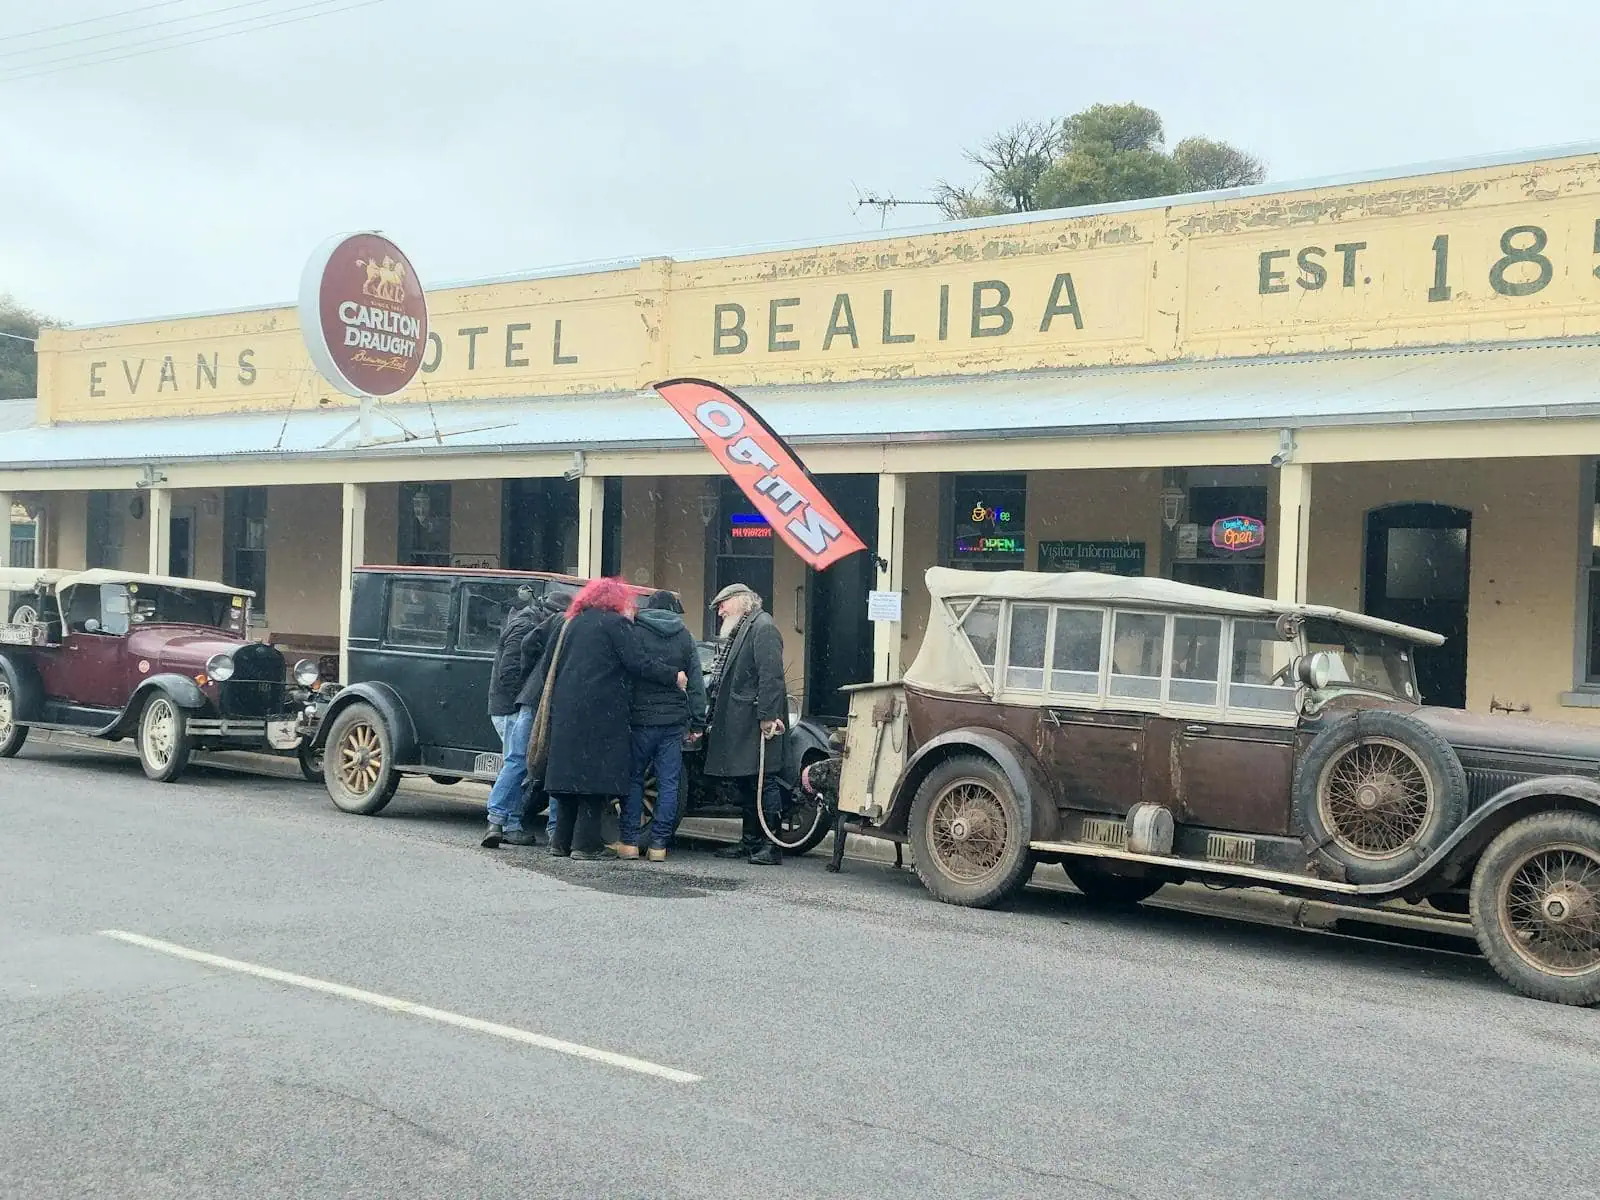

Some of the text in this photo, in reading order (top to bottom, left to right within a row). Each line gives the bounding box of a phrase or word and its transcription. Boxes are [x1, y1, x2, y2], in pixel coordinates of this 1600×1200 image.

[90, 349, 257, 397] EVANS
[421, 320, 578, 373] OTEL
[713, 273, 1084, 355] BEALIBA
[1259, 241, 1371, 294] EST.
[339, 301, 420, 339] CARLTON
[344, 326, 415, 357] DRAUGHT
[1041, 543, 1141, 559] Visitor Information
[1224, 528, 1255, 549] Open
